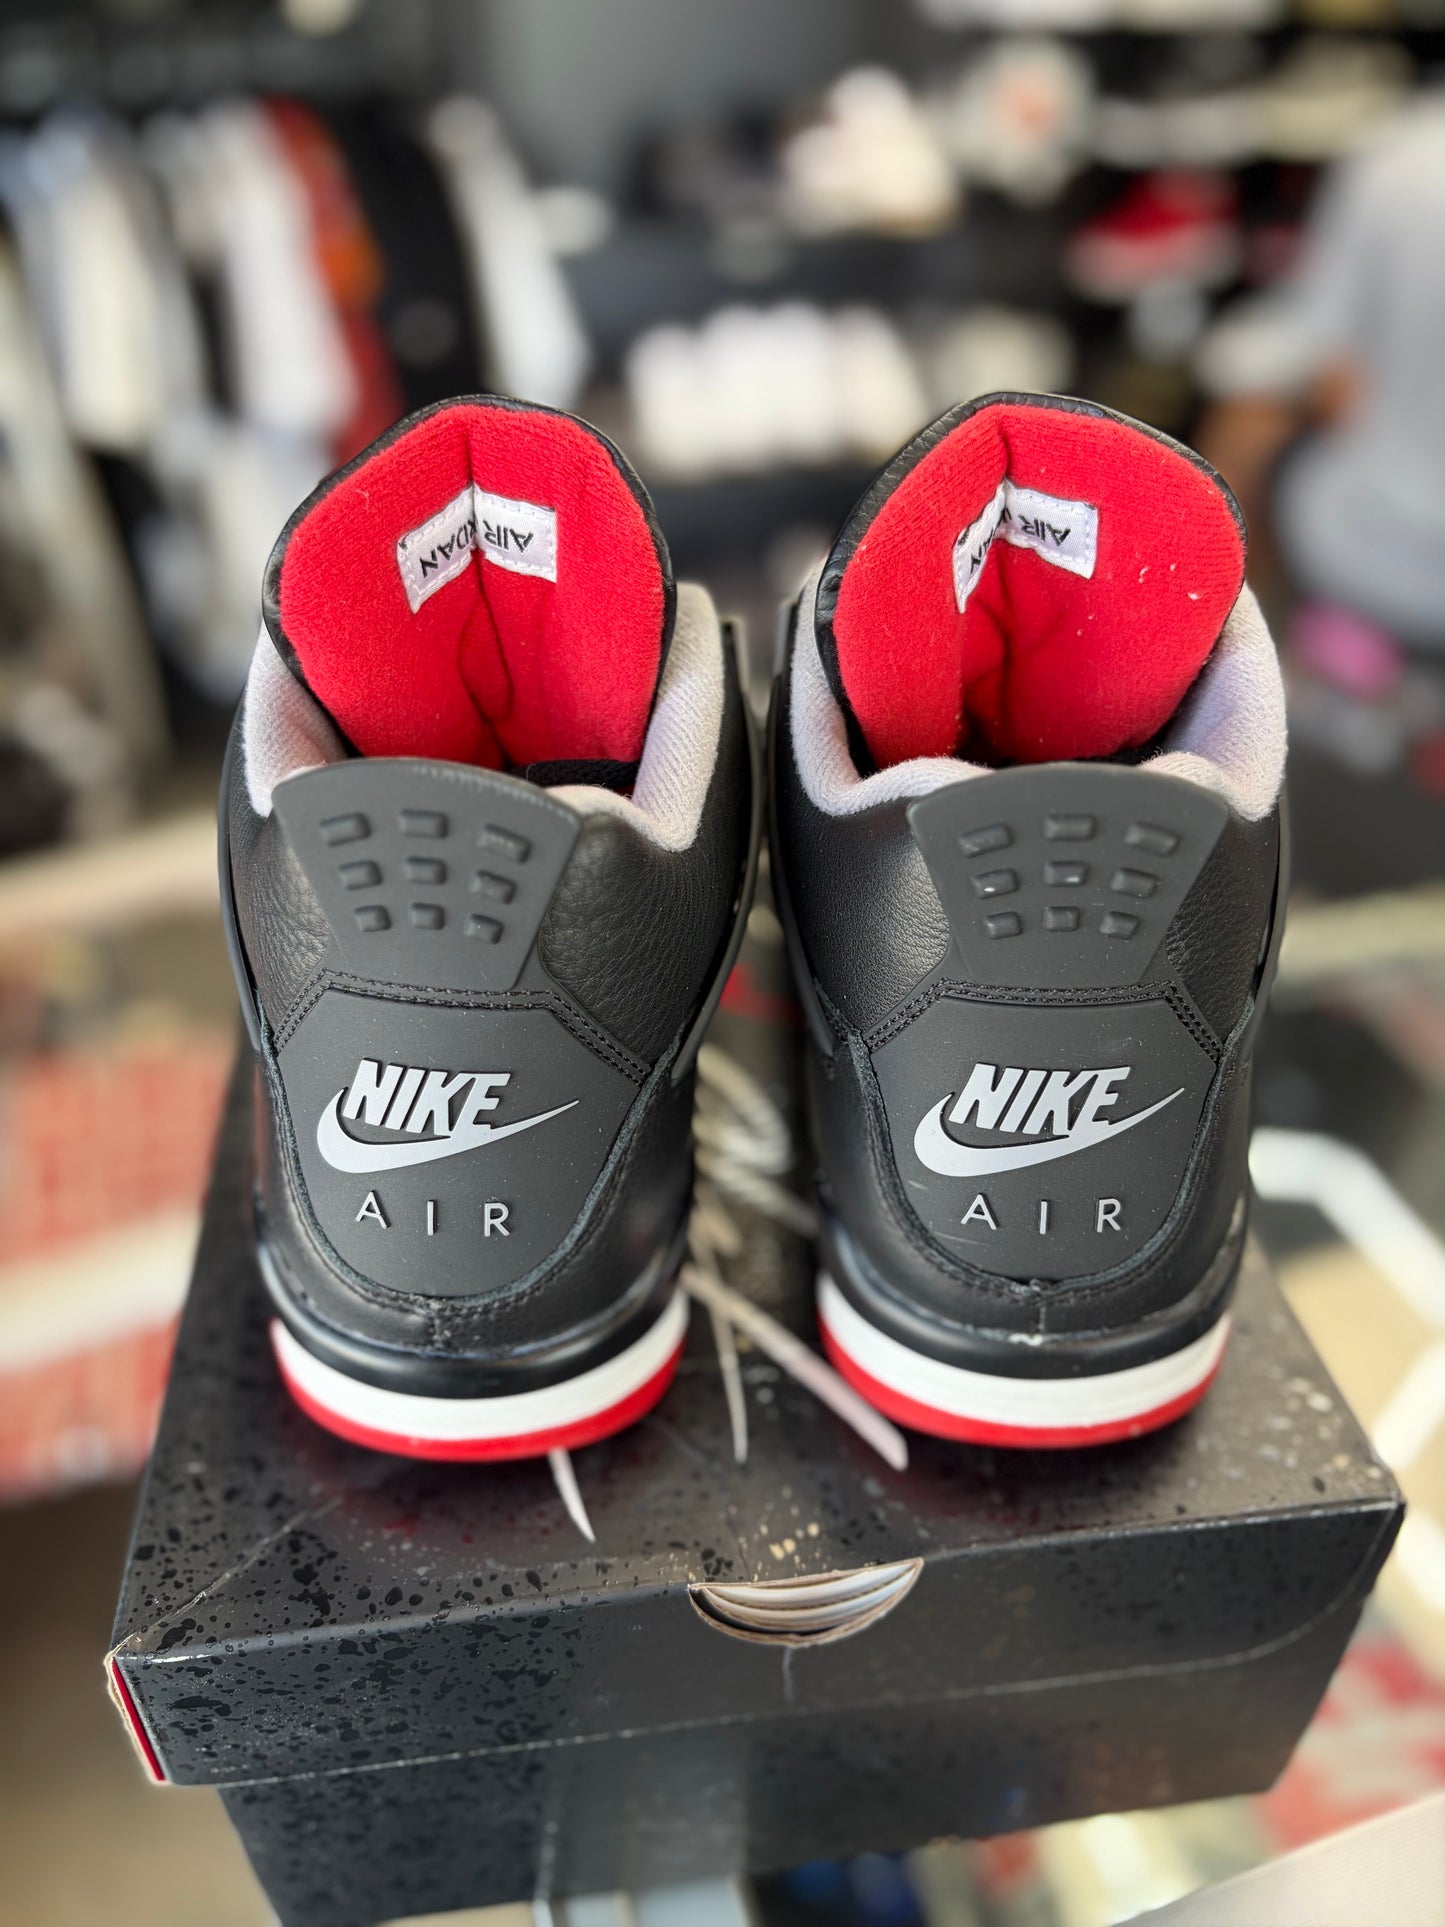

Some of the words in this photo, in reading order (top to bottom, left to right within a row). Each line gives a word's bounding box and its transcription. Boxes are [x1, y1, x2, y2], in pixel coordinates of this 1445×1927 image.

[483, 519, 534, 553] AIR
[1018, 514, 1072, 547] AIR
[342, 1058, 511, 1136] NIKE
[948, 1063, 1131, 1136] NIKE
[355, 1190, 511, 1238] AIR
[960, 1193, 1122, 1236] AIR
